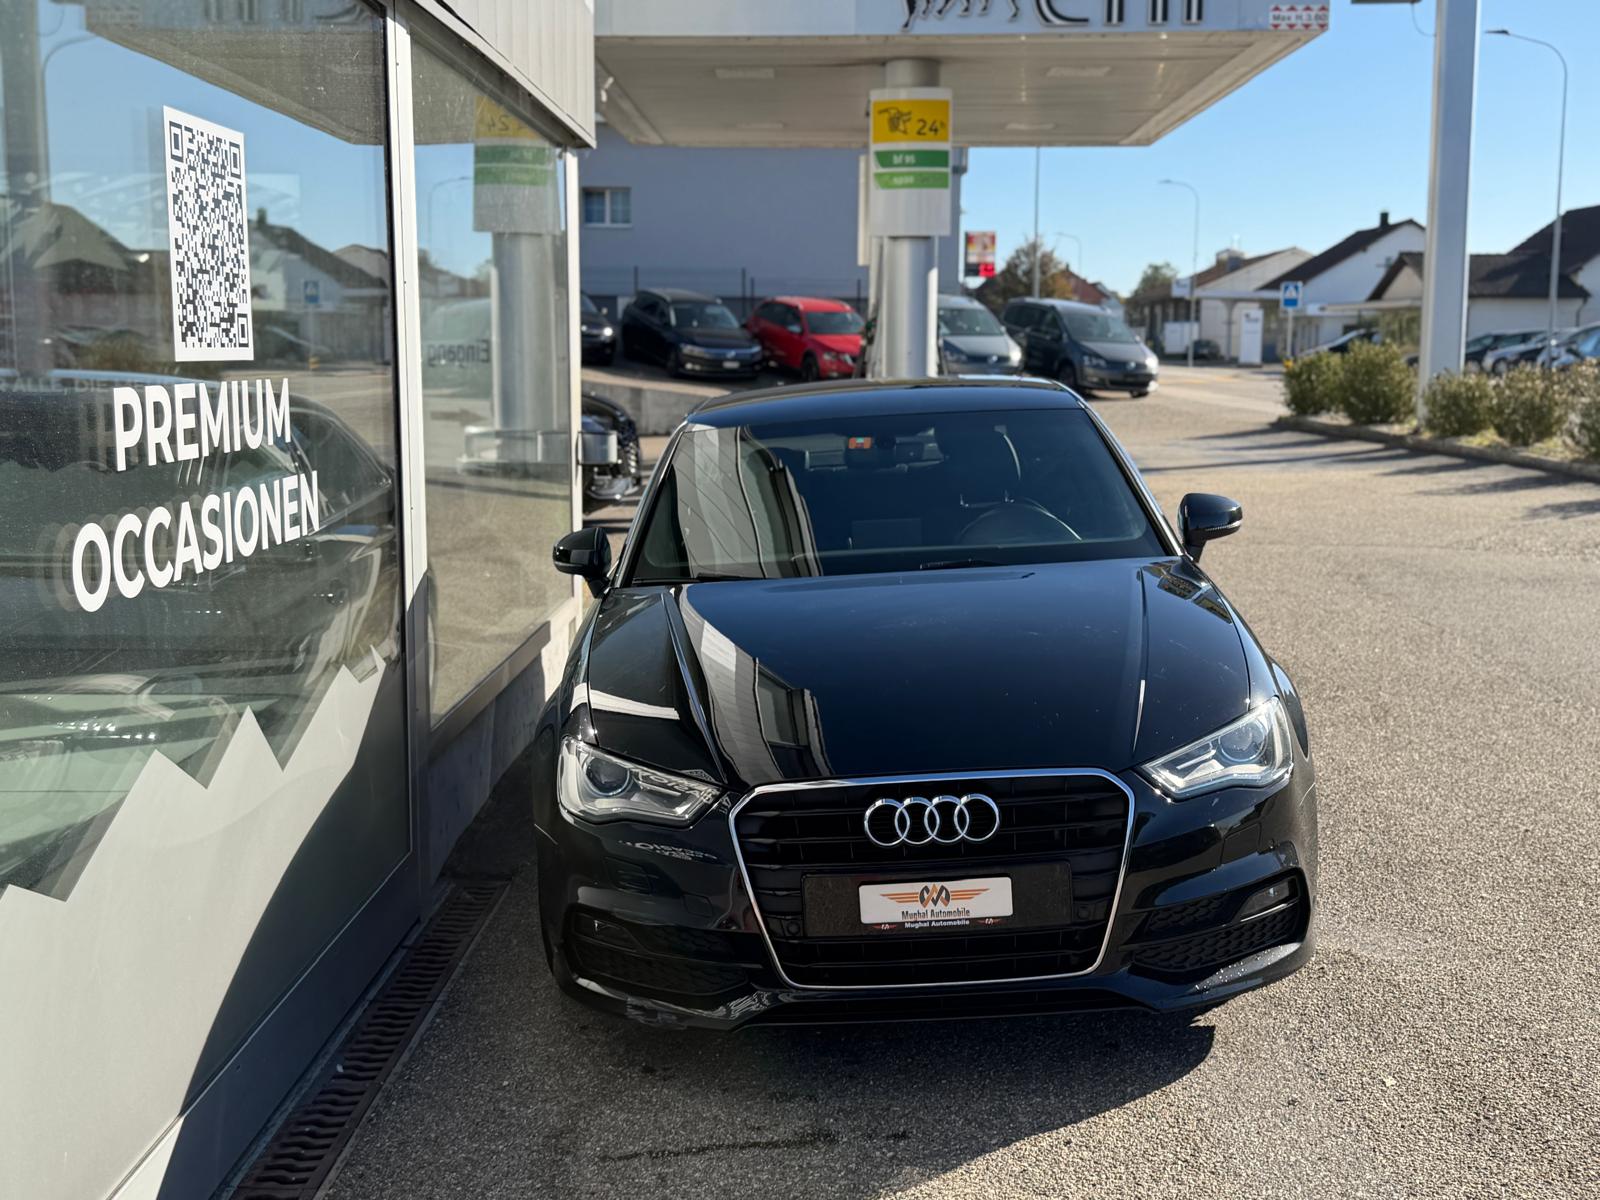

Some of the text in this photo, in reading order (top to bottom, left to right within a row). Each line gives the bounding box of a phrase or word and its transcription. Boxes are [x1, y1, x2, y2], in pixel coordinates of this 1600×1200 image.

[113, 378, 291, 472] PREMIUM
[72, 470, 320, 613] OCCASIONEN
[901, 907, 970, 921] Mughal Automobile
[904, 919, 970, 928] Mughal Automobile
